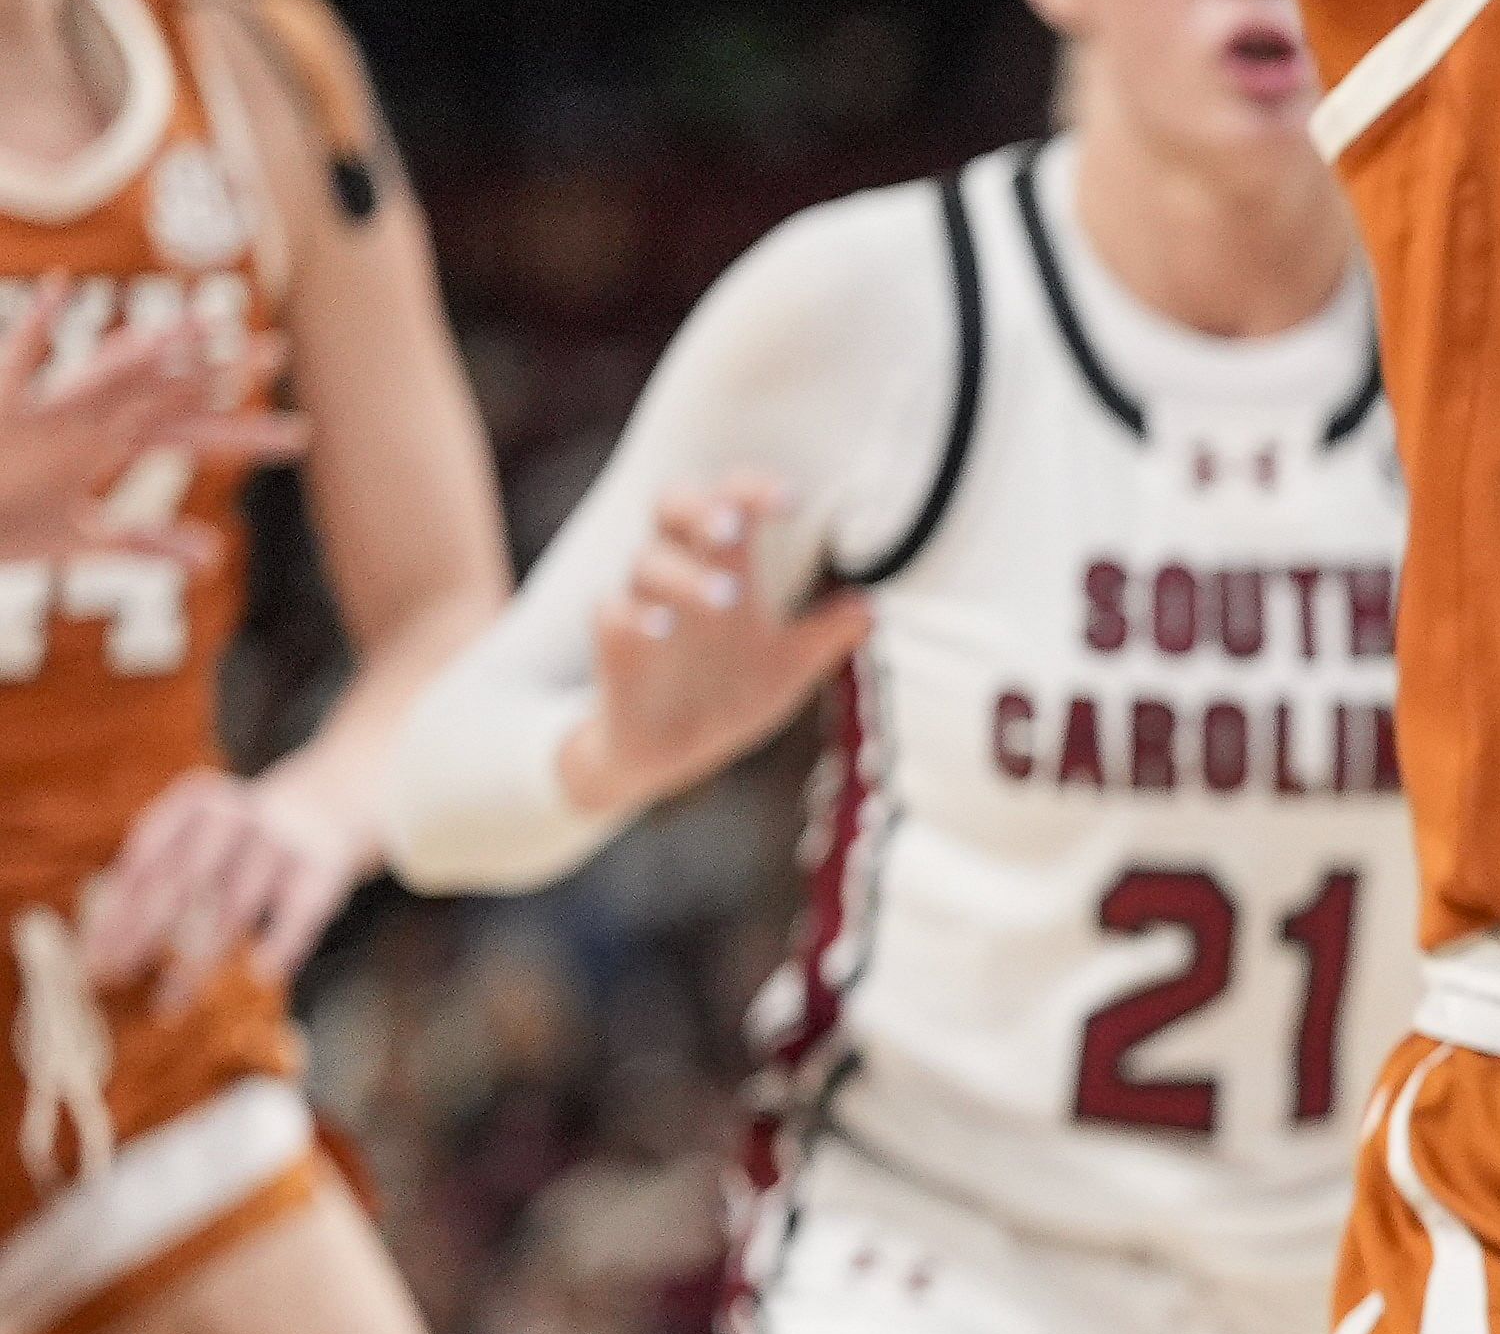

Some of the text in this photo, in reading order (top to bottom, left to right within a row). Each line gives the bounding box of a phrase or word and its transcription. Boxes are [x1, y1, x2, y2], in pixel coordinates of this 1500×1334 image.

[1082, 559, 1398, 659] SOUTH
[990, 687, 1403, 795] CAROLIN
[1070, 865, 1360, 1135] 21
